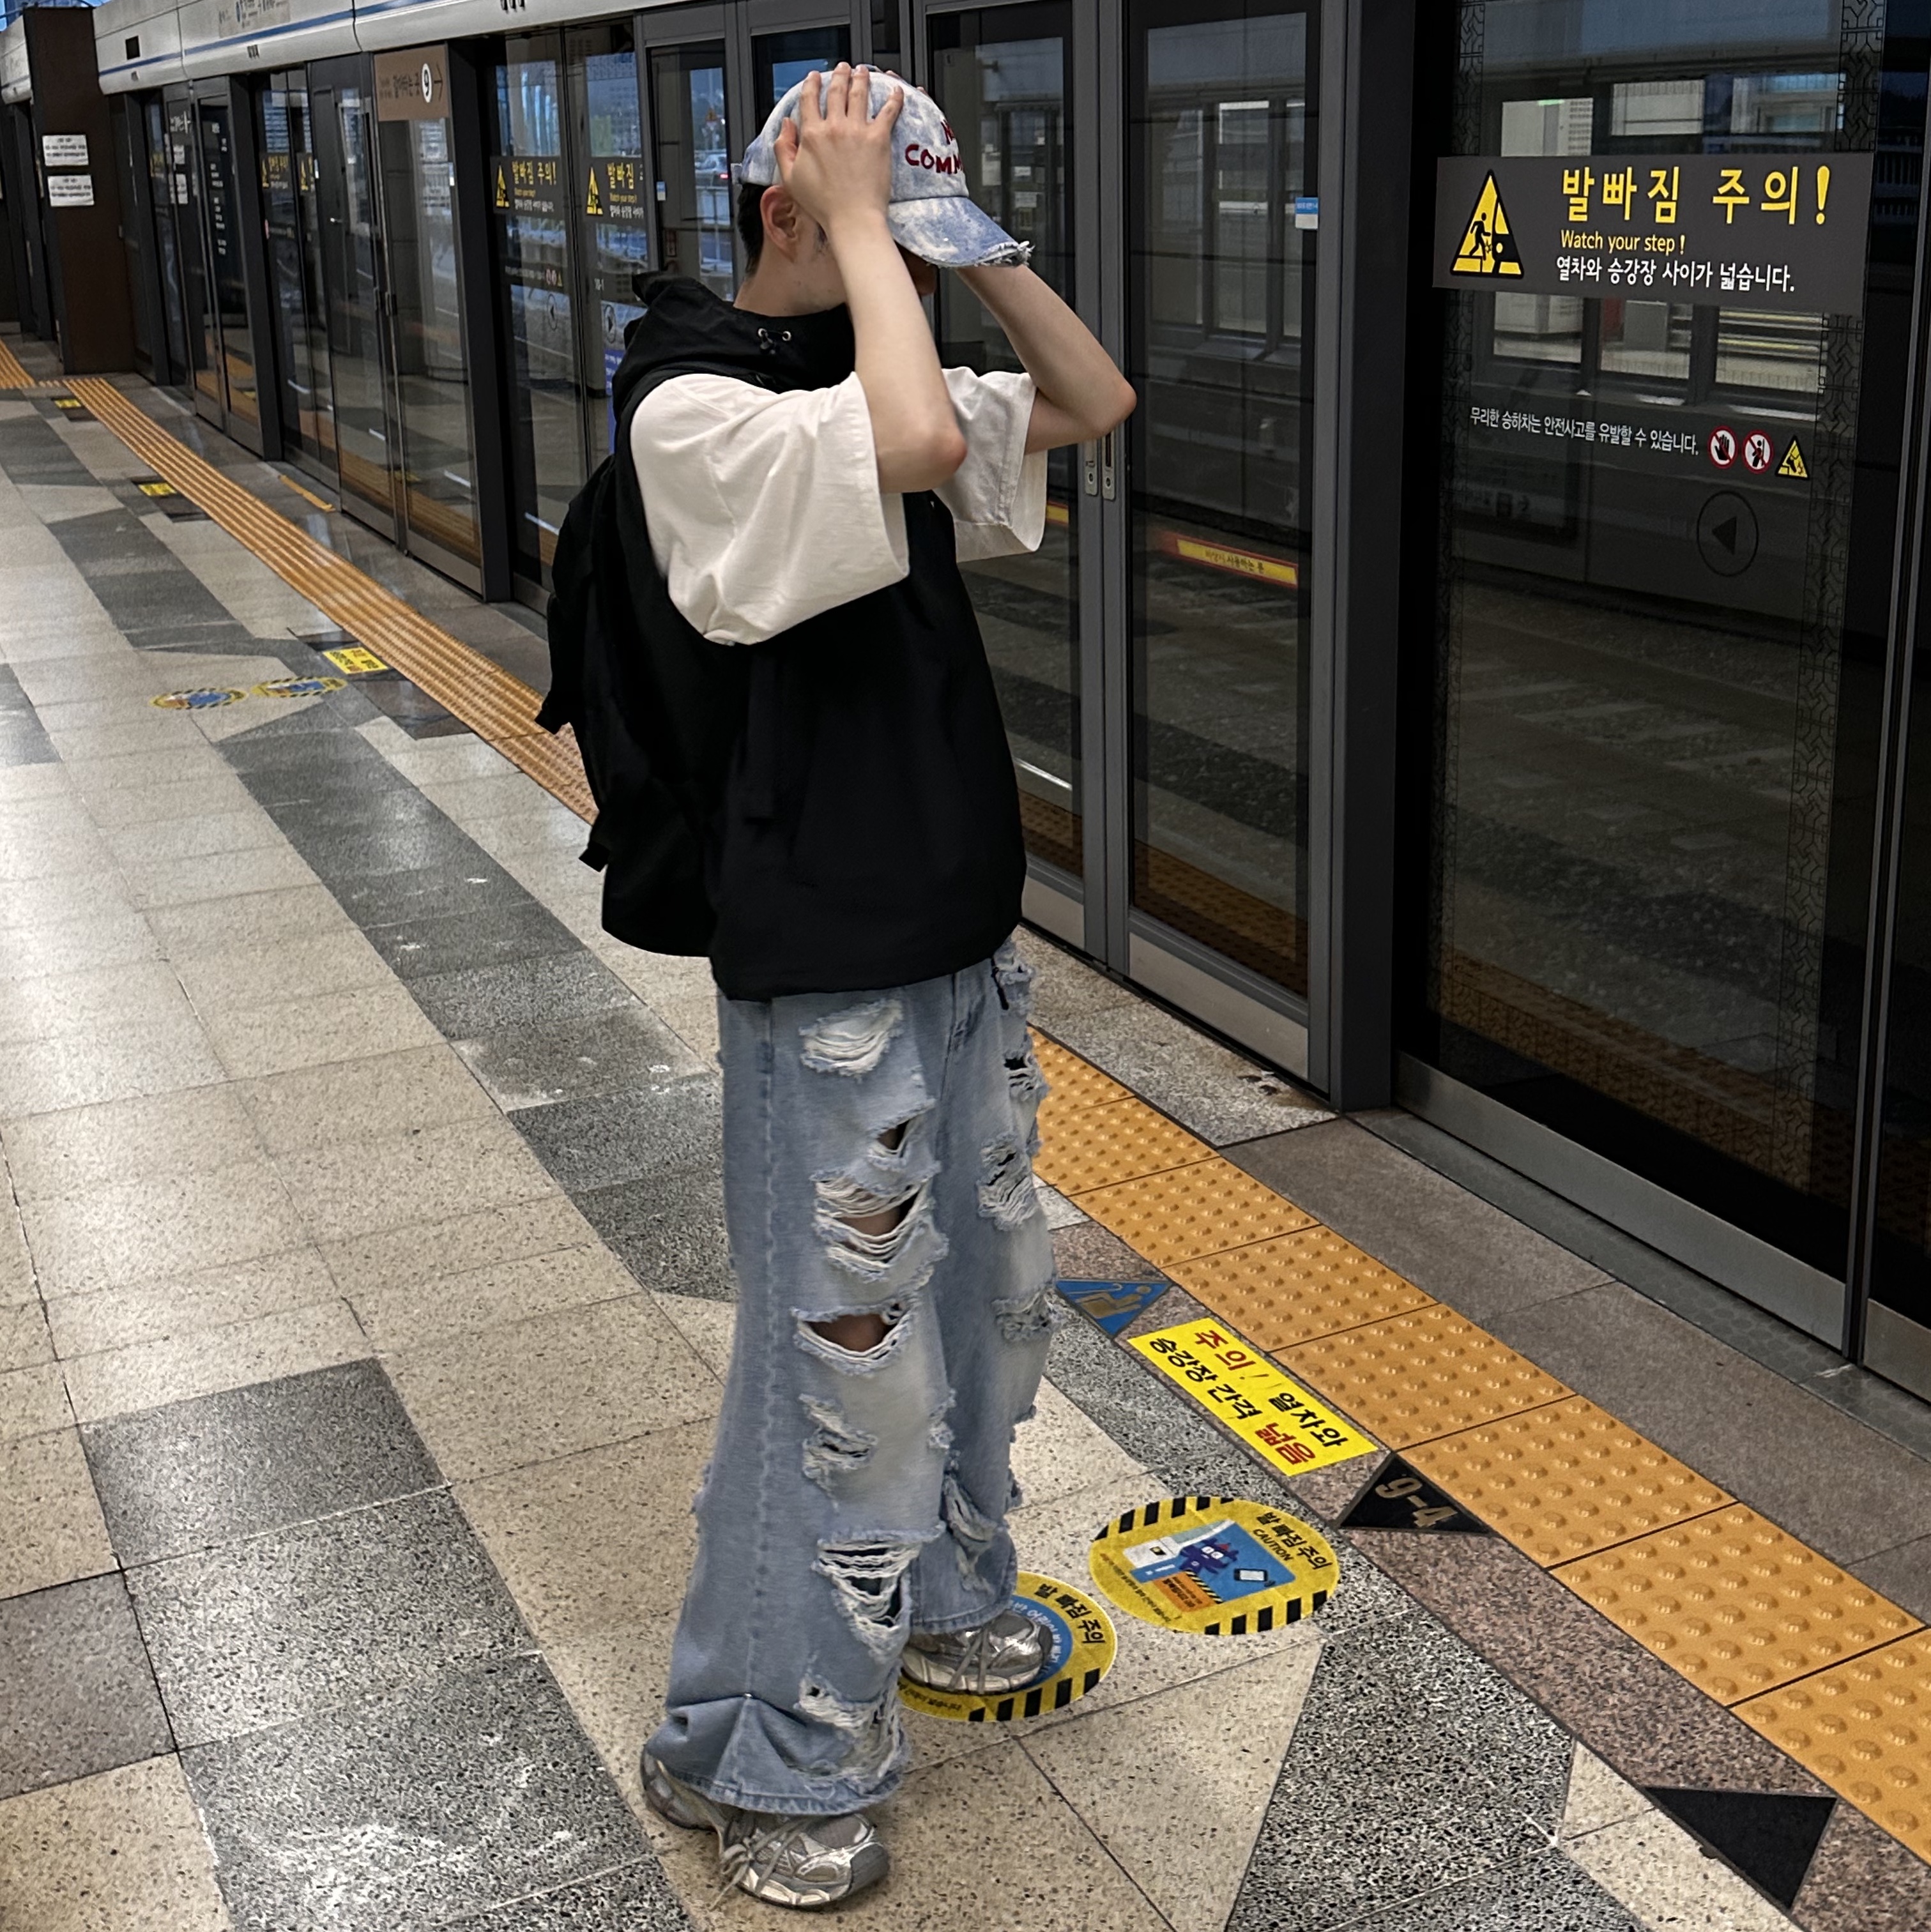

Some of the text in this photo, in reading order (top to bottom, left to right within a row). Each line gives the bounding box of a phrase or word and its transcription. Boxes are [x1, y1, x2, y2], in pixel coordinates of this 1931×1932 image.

[424, 69, 429, 96] 9
[1562, 165, 1831, 225] 발빠짐 주의!
[1561, 229, 1603, 250] Watch
[1608, 234, 1640, 254] your
[1556, 255, 1795, 293] 열차와 승강장 사이가 넓습니다.
[1470, 407, 1699, 455] 무리한 승하차는 안전사고를 유발할 수 있습니다.
[1150, 1338, 1316, 1465] 승강장 간격 넓음
[1268, 1392, 1348, 1447] 열차와
[1375, 1477, 1458, 1527] 9-4
[1253, 1528, 1294, 1561] CAUTION
[1297, 1546, 1333, 1570] 주의
[1078, 1619, 1106, 1644] 주의
